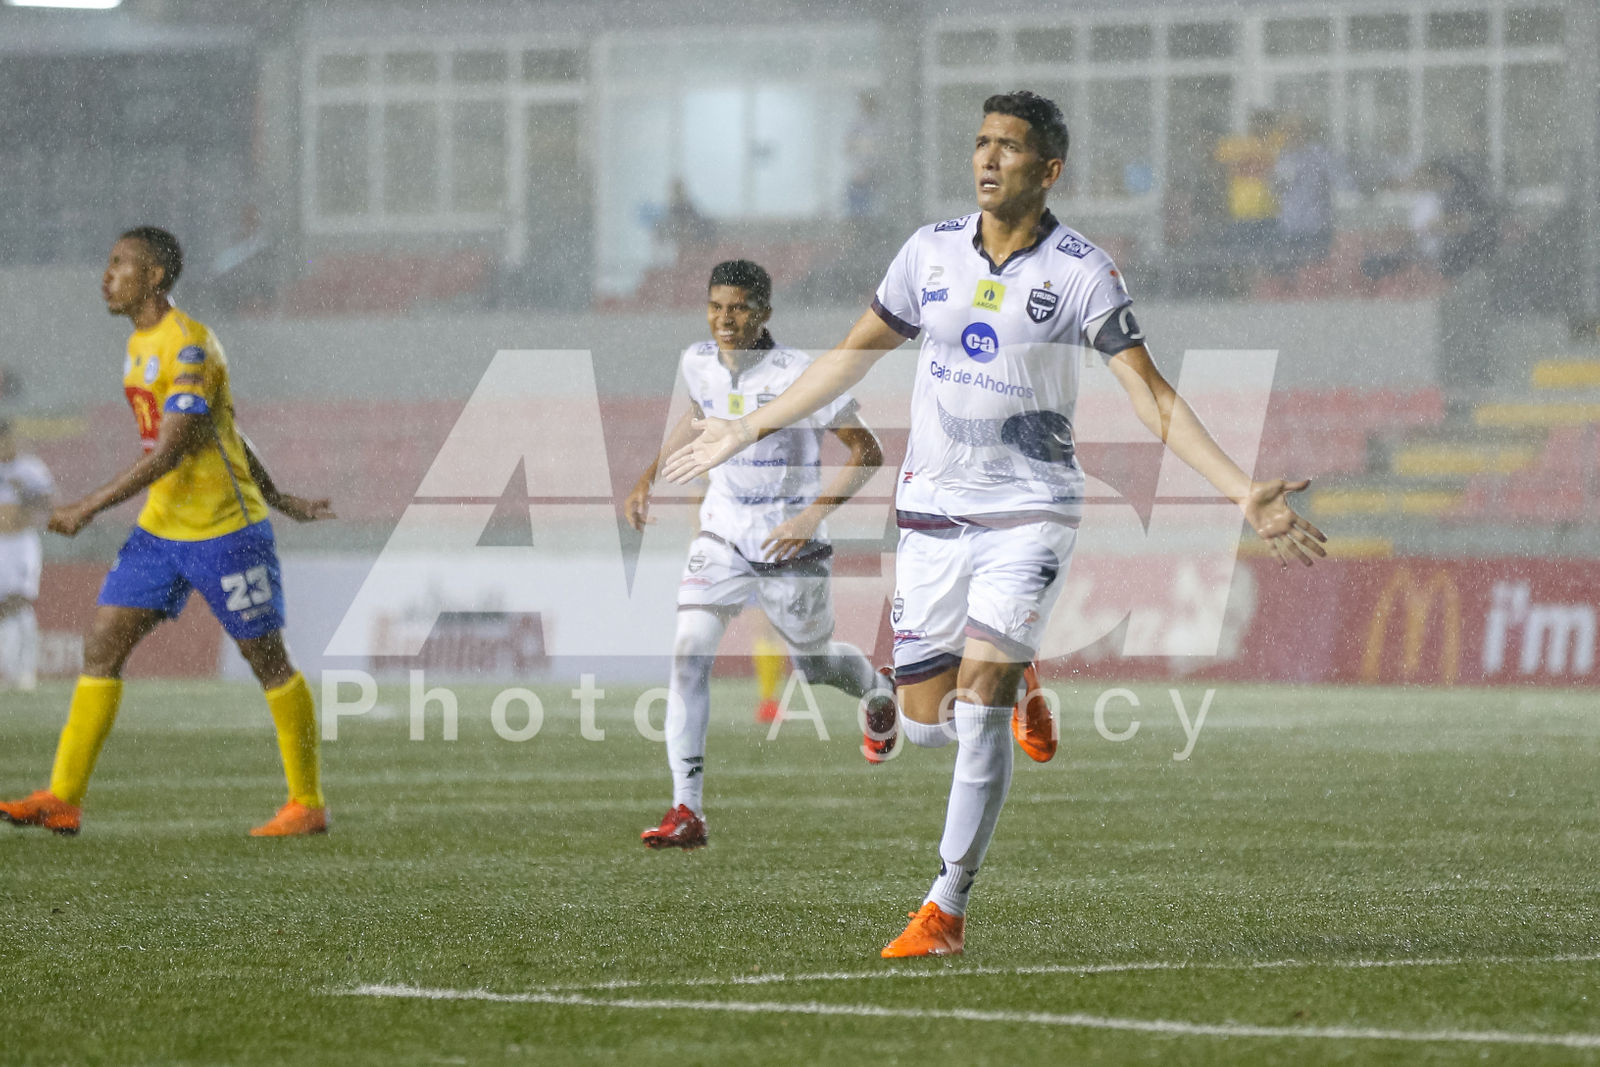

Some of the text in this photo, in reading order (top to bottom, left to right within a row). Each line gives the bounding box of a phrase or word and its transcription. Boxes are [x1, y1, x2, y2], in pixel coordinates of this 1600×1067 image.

[965, 333, 996, 353] ca
[930, 361, 1034, 399] Caja de Ahorros
[220, 565, 274, 612] 23
